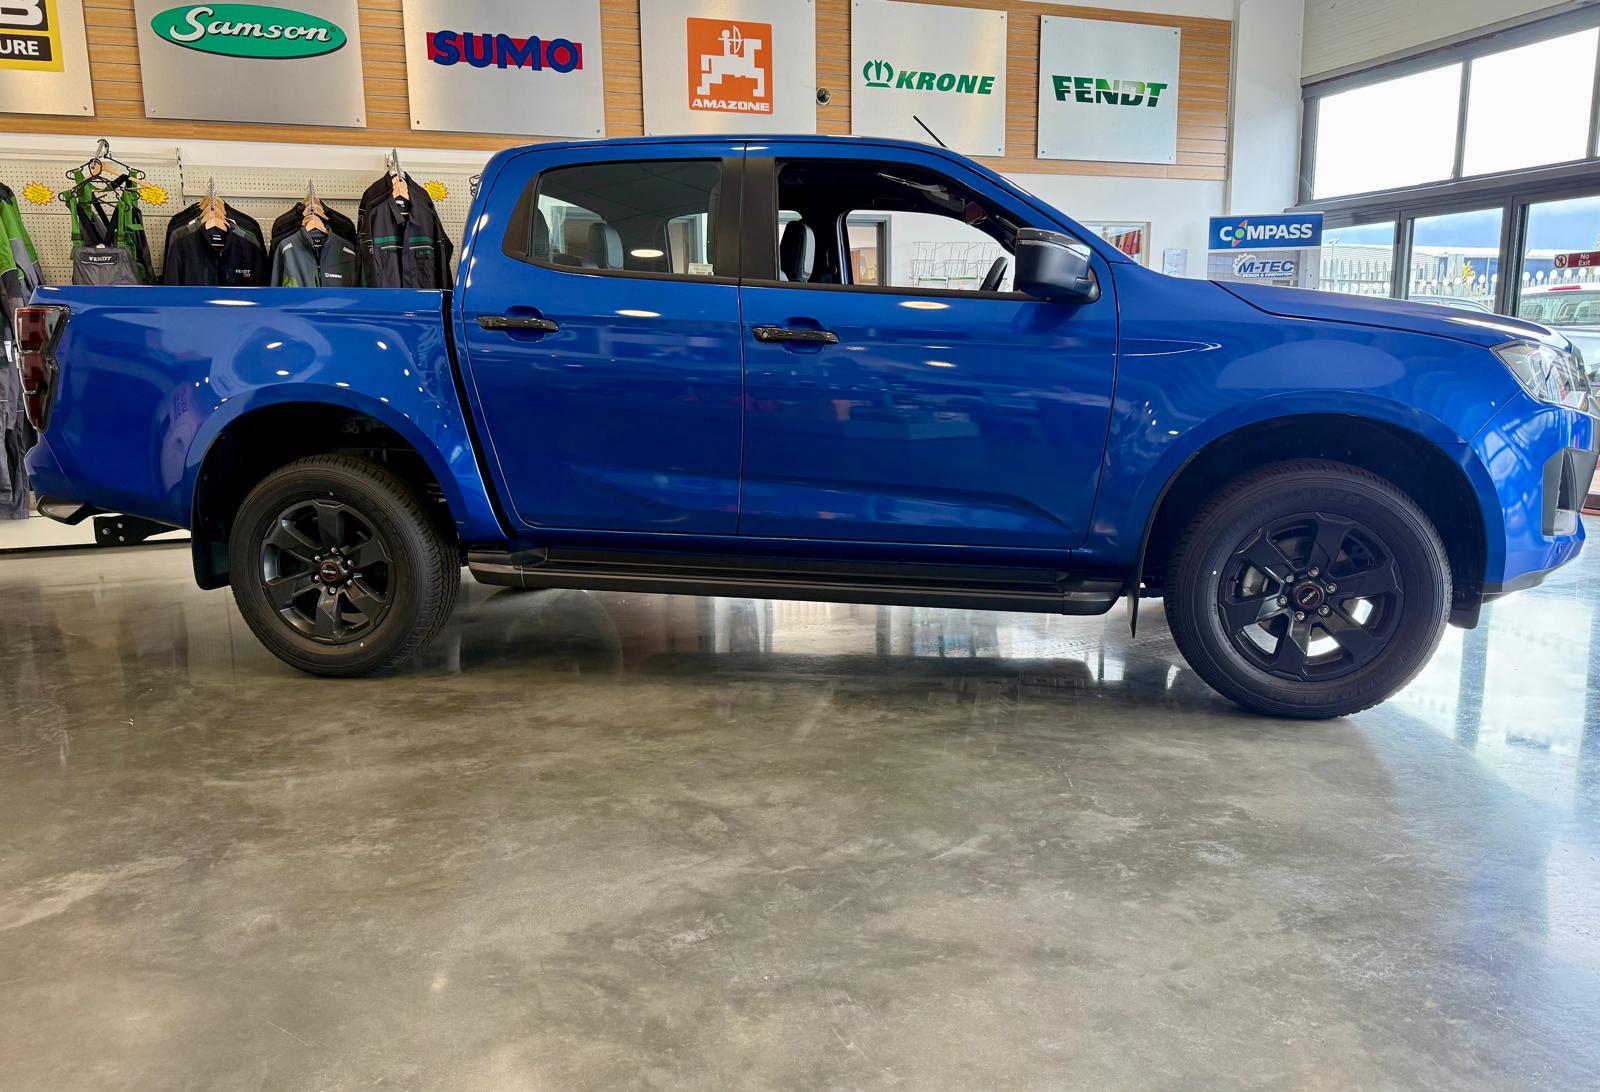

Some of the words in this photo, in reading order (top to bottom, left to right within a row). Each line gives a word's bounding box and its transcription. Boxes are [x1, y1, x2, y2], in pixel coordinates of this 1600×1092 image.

[170, 7, 332, 42] Samson
[0, 39, 40, 56] URE
[432, 30, 580, 73] SUMO
[895, 71, 996, 95] KRONE
[1051, 75, 1168, 108] FENDT
[691, 98, 770, 112] AMAZONE
[1219, 223, 1313, 243] COMPASS
[1238, 260, 1294, 273] M-TEC
